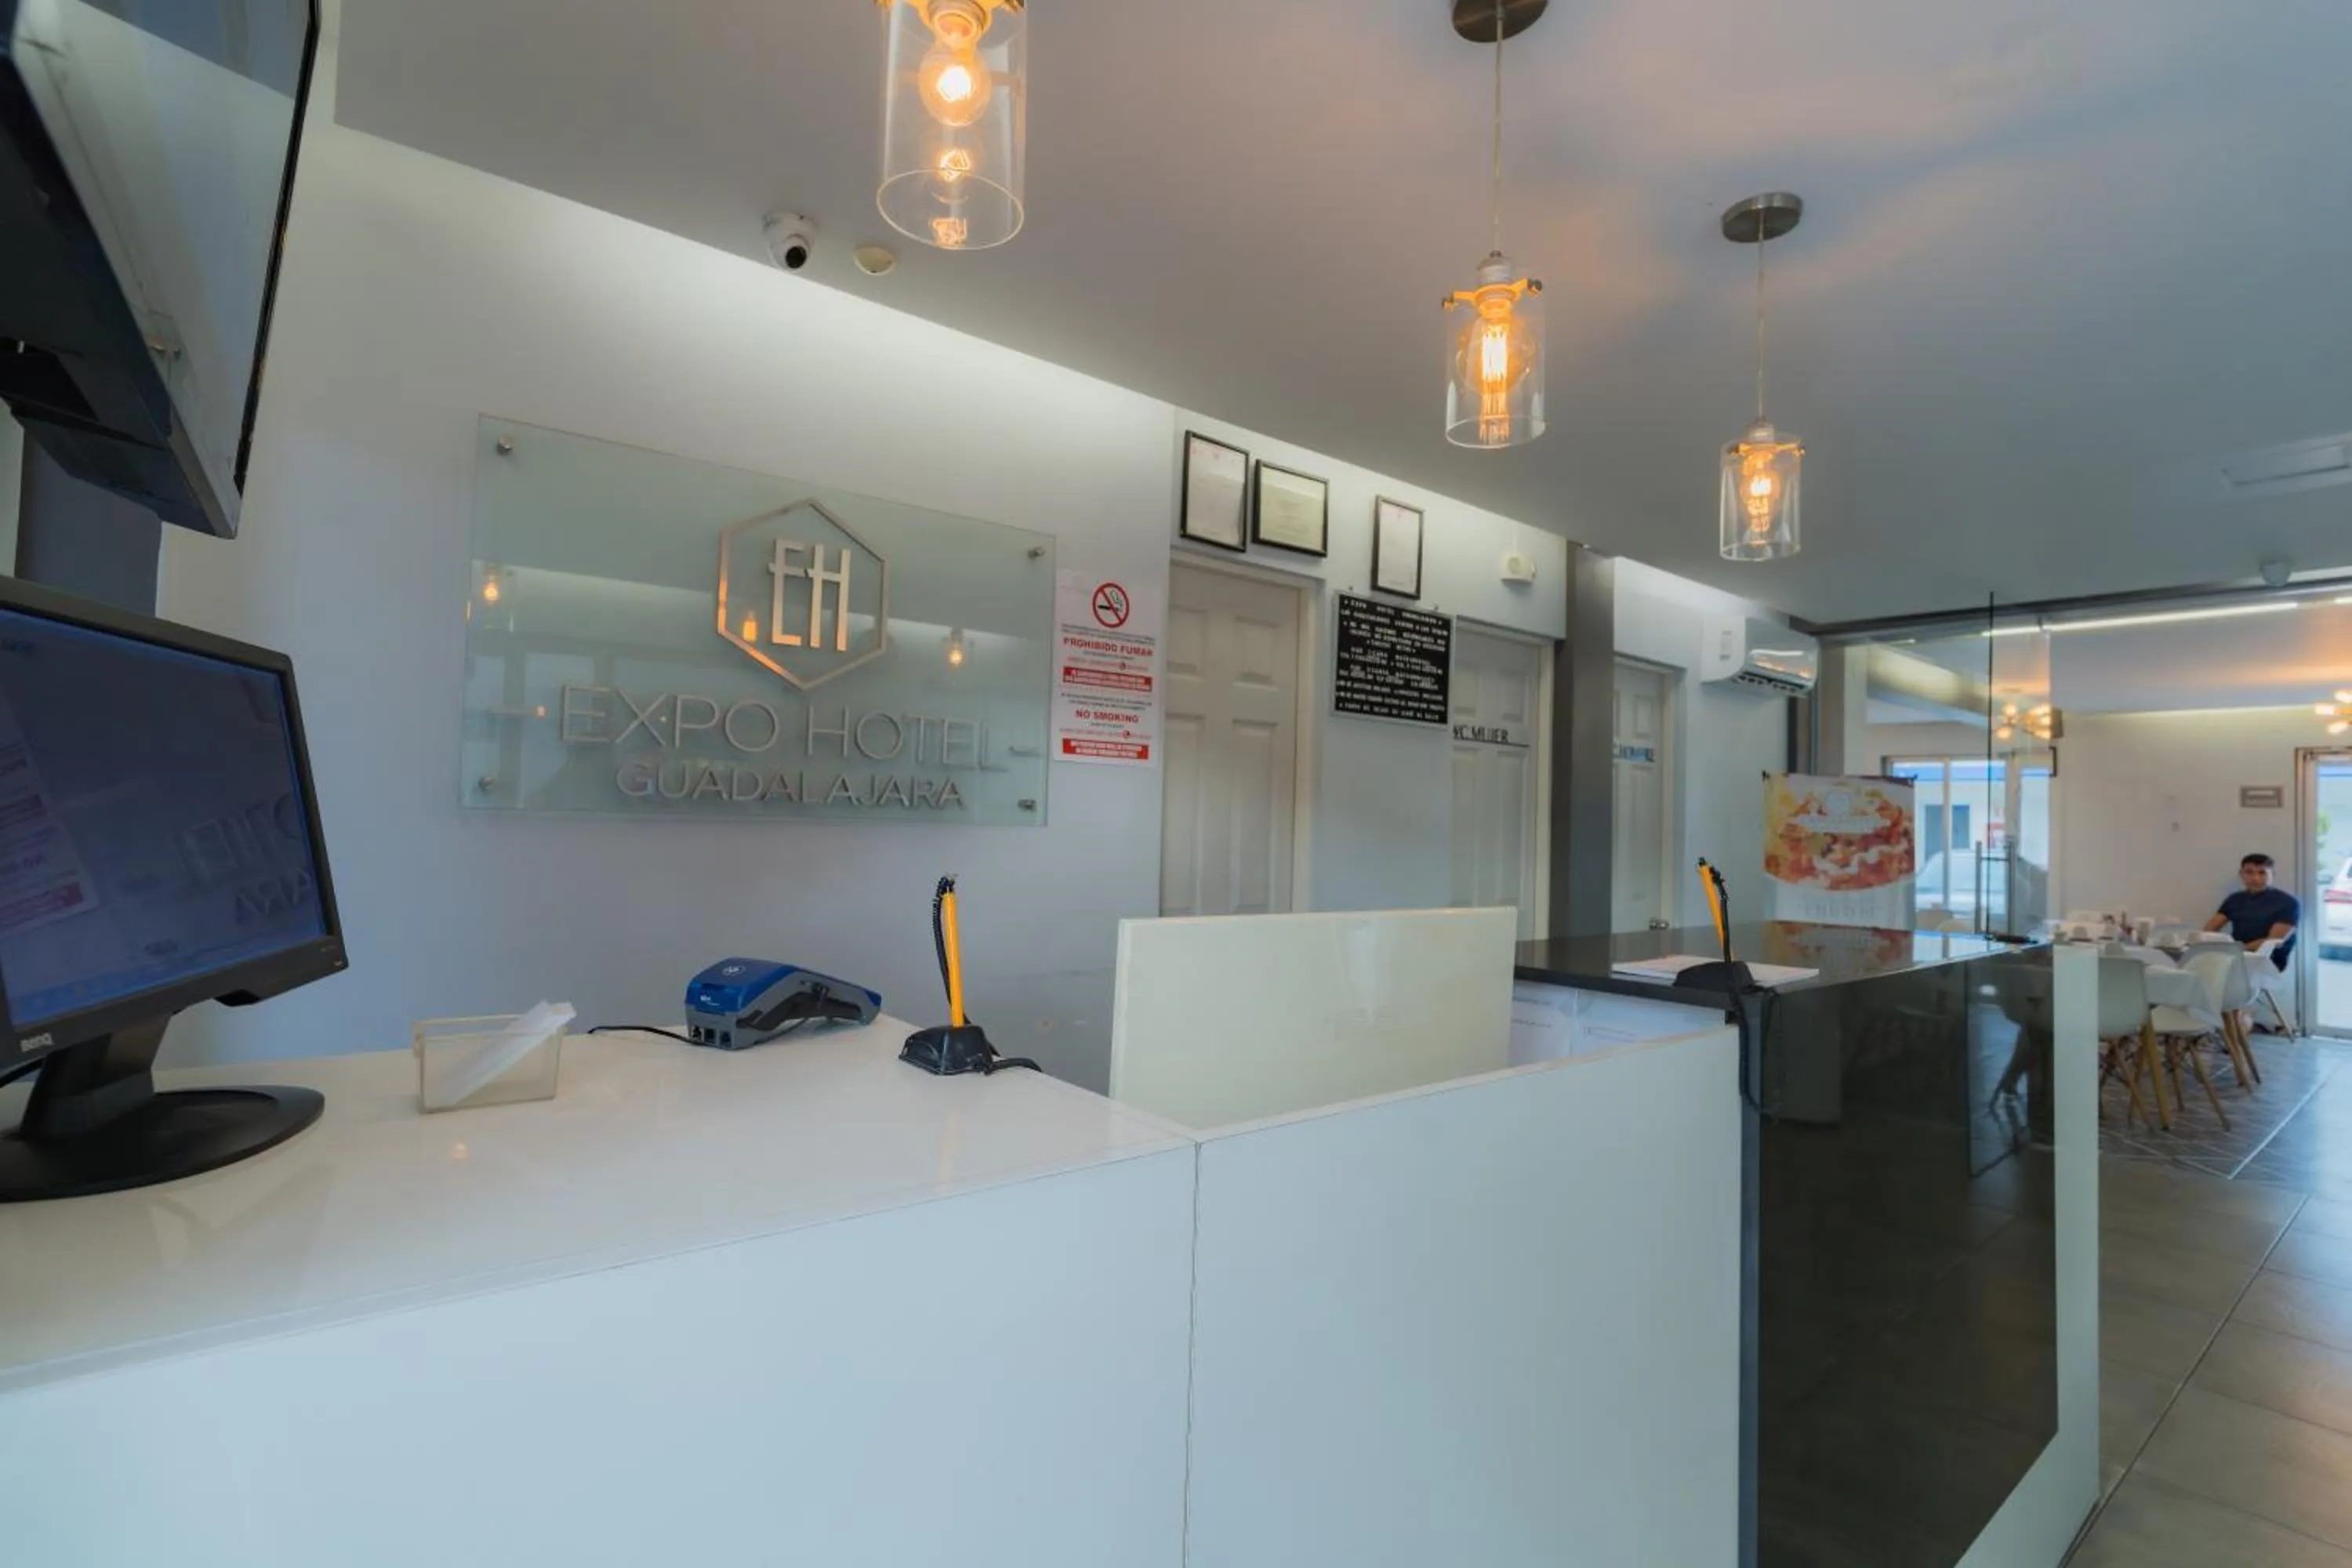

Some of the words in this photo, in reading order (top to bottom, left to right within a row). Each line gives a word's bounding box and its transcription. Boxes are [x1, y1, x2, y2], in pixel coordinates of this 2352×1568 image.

[1063, 637, 1117, 652] PROHIBIDO
[1120, 645, 1153, 656] FUMAR
[561, 683, 780, 753] EXPO
[807, 705, 1009, 772] HOTEL
[1076, 709, 1091, 719] NO
[1094, 710, 1139, 723] SMOKING
[616, 762, 967, 810] GUADALAJARA
